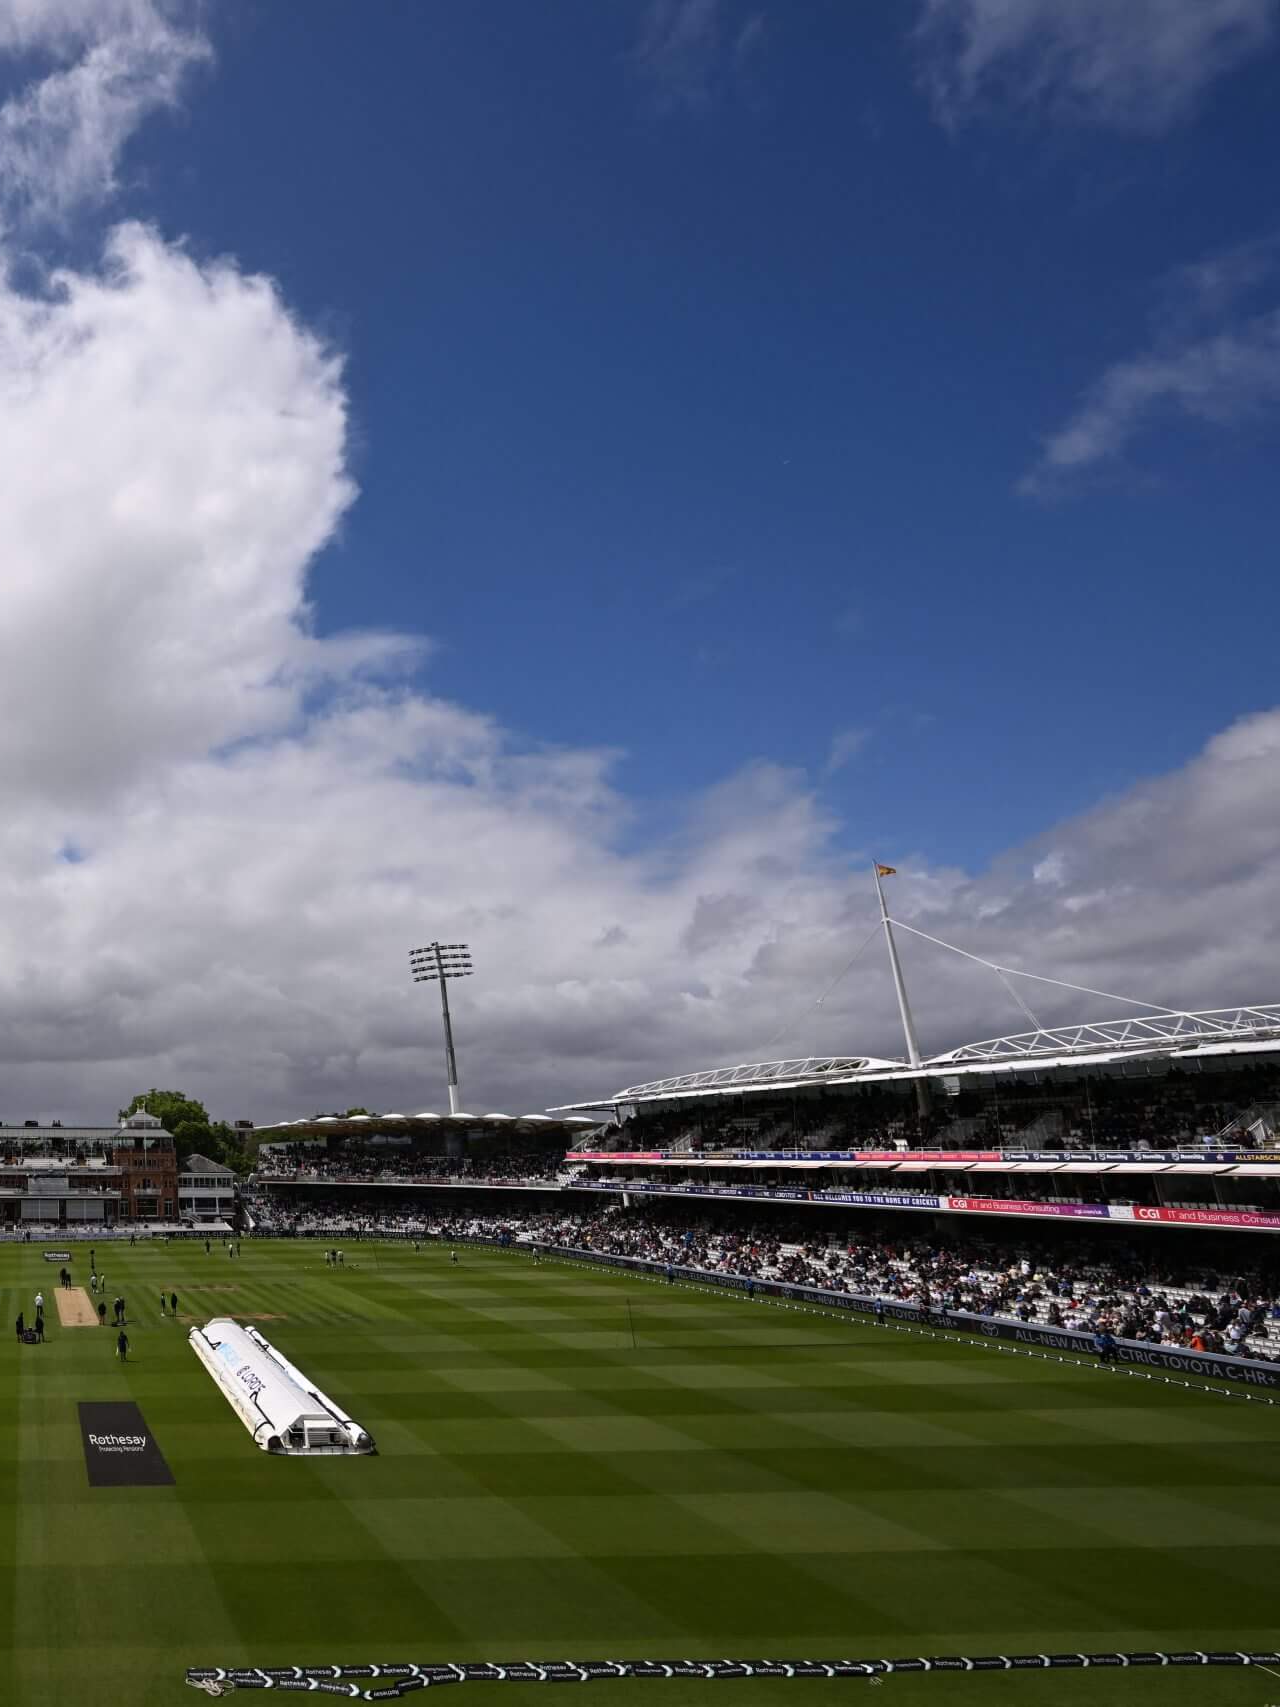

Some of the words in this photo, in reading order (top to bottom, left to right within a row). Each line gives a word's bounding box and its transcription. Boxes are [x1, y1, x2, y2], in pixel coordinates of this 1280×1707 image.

[825, 1193, 852, 1202] WELCOMES
[903, 1197, 910, 1205] OF
[912, 1198, 938, 1206] CRICKET
[953, 1199, 968, 1209] CGI
[993, 1203, 1021, 1211] Business
[1023, 1204, 1060, 1214] Consulting
[1139, 1208, 1160, 1219] CGI
[1167, 1210, 1175, 1219] IT
[1178, 1211, 1196, 1221] and
[1198, 1211, 1243, 1223] Business
[1016, 1329, 1067, 1349] ALL-NEW
[1162, 1356, 1223, 1378] TOYOTA
[1227, 1365, 1277, 1386] C-HR+
[89, 1434, 146, 1447] Rothesay
[280, 1680, 307, 1688] Rothesay
[433, 1673, 457, 1682] Rothesay
